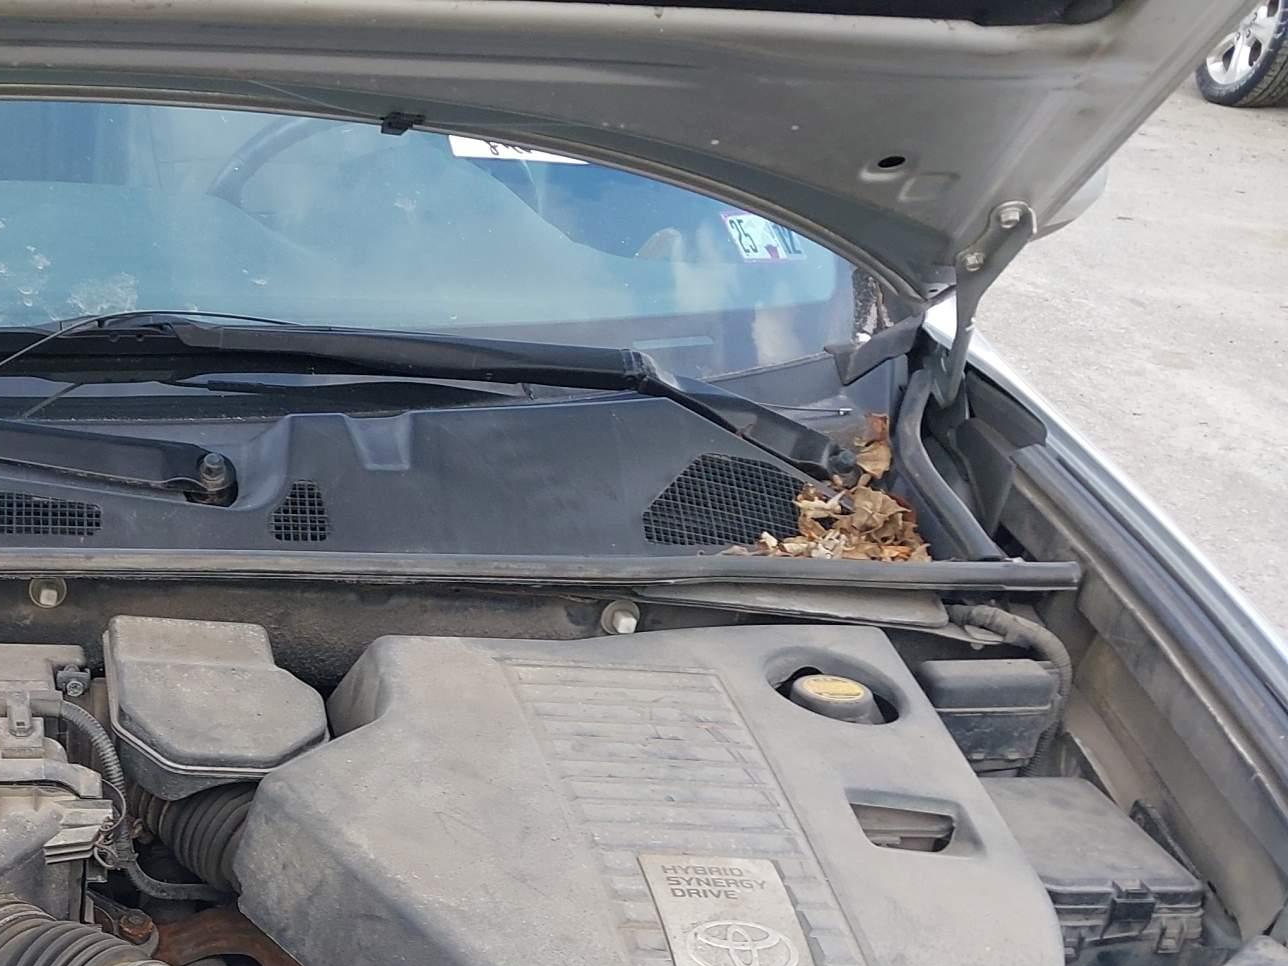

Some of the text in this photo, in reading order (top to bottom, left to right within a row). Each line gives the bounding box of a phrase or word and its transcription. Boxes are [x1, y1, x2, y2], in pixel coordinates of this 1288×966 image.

[728, 218, 758, 254] 25
[661, 864, 744, 877] HYBRID
[666, 875, 766, 890] SYNERGY
[670, 887, 738, 900] DRIVE
